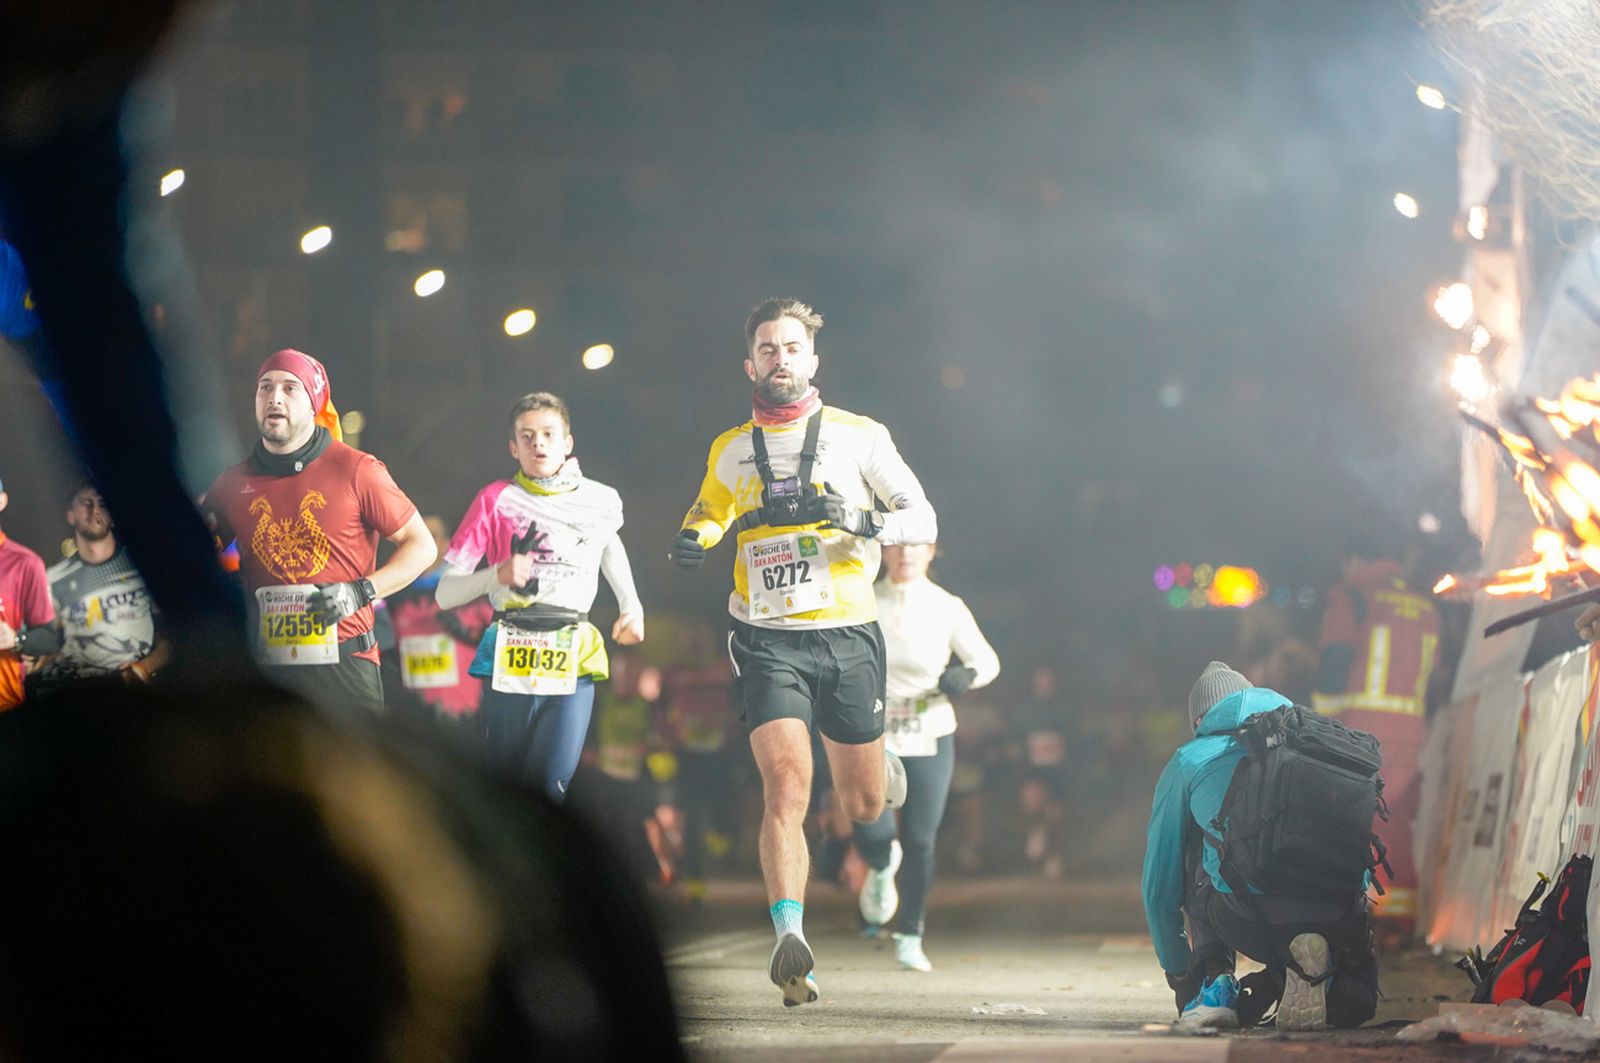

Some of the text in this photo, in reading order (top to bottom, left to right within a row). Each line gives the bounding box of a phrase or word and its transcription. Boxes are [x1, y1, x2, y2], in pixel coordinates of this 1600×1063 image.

[781, 543, 791, 552] DE
[762, 560, 812, 591] 6272
[507, 648, 567, 672] 13032
